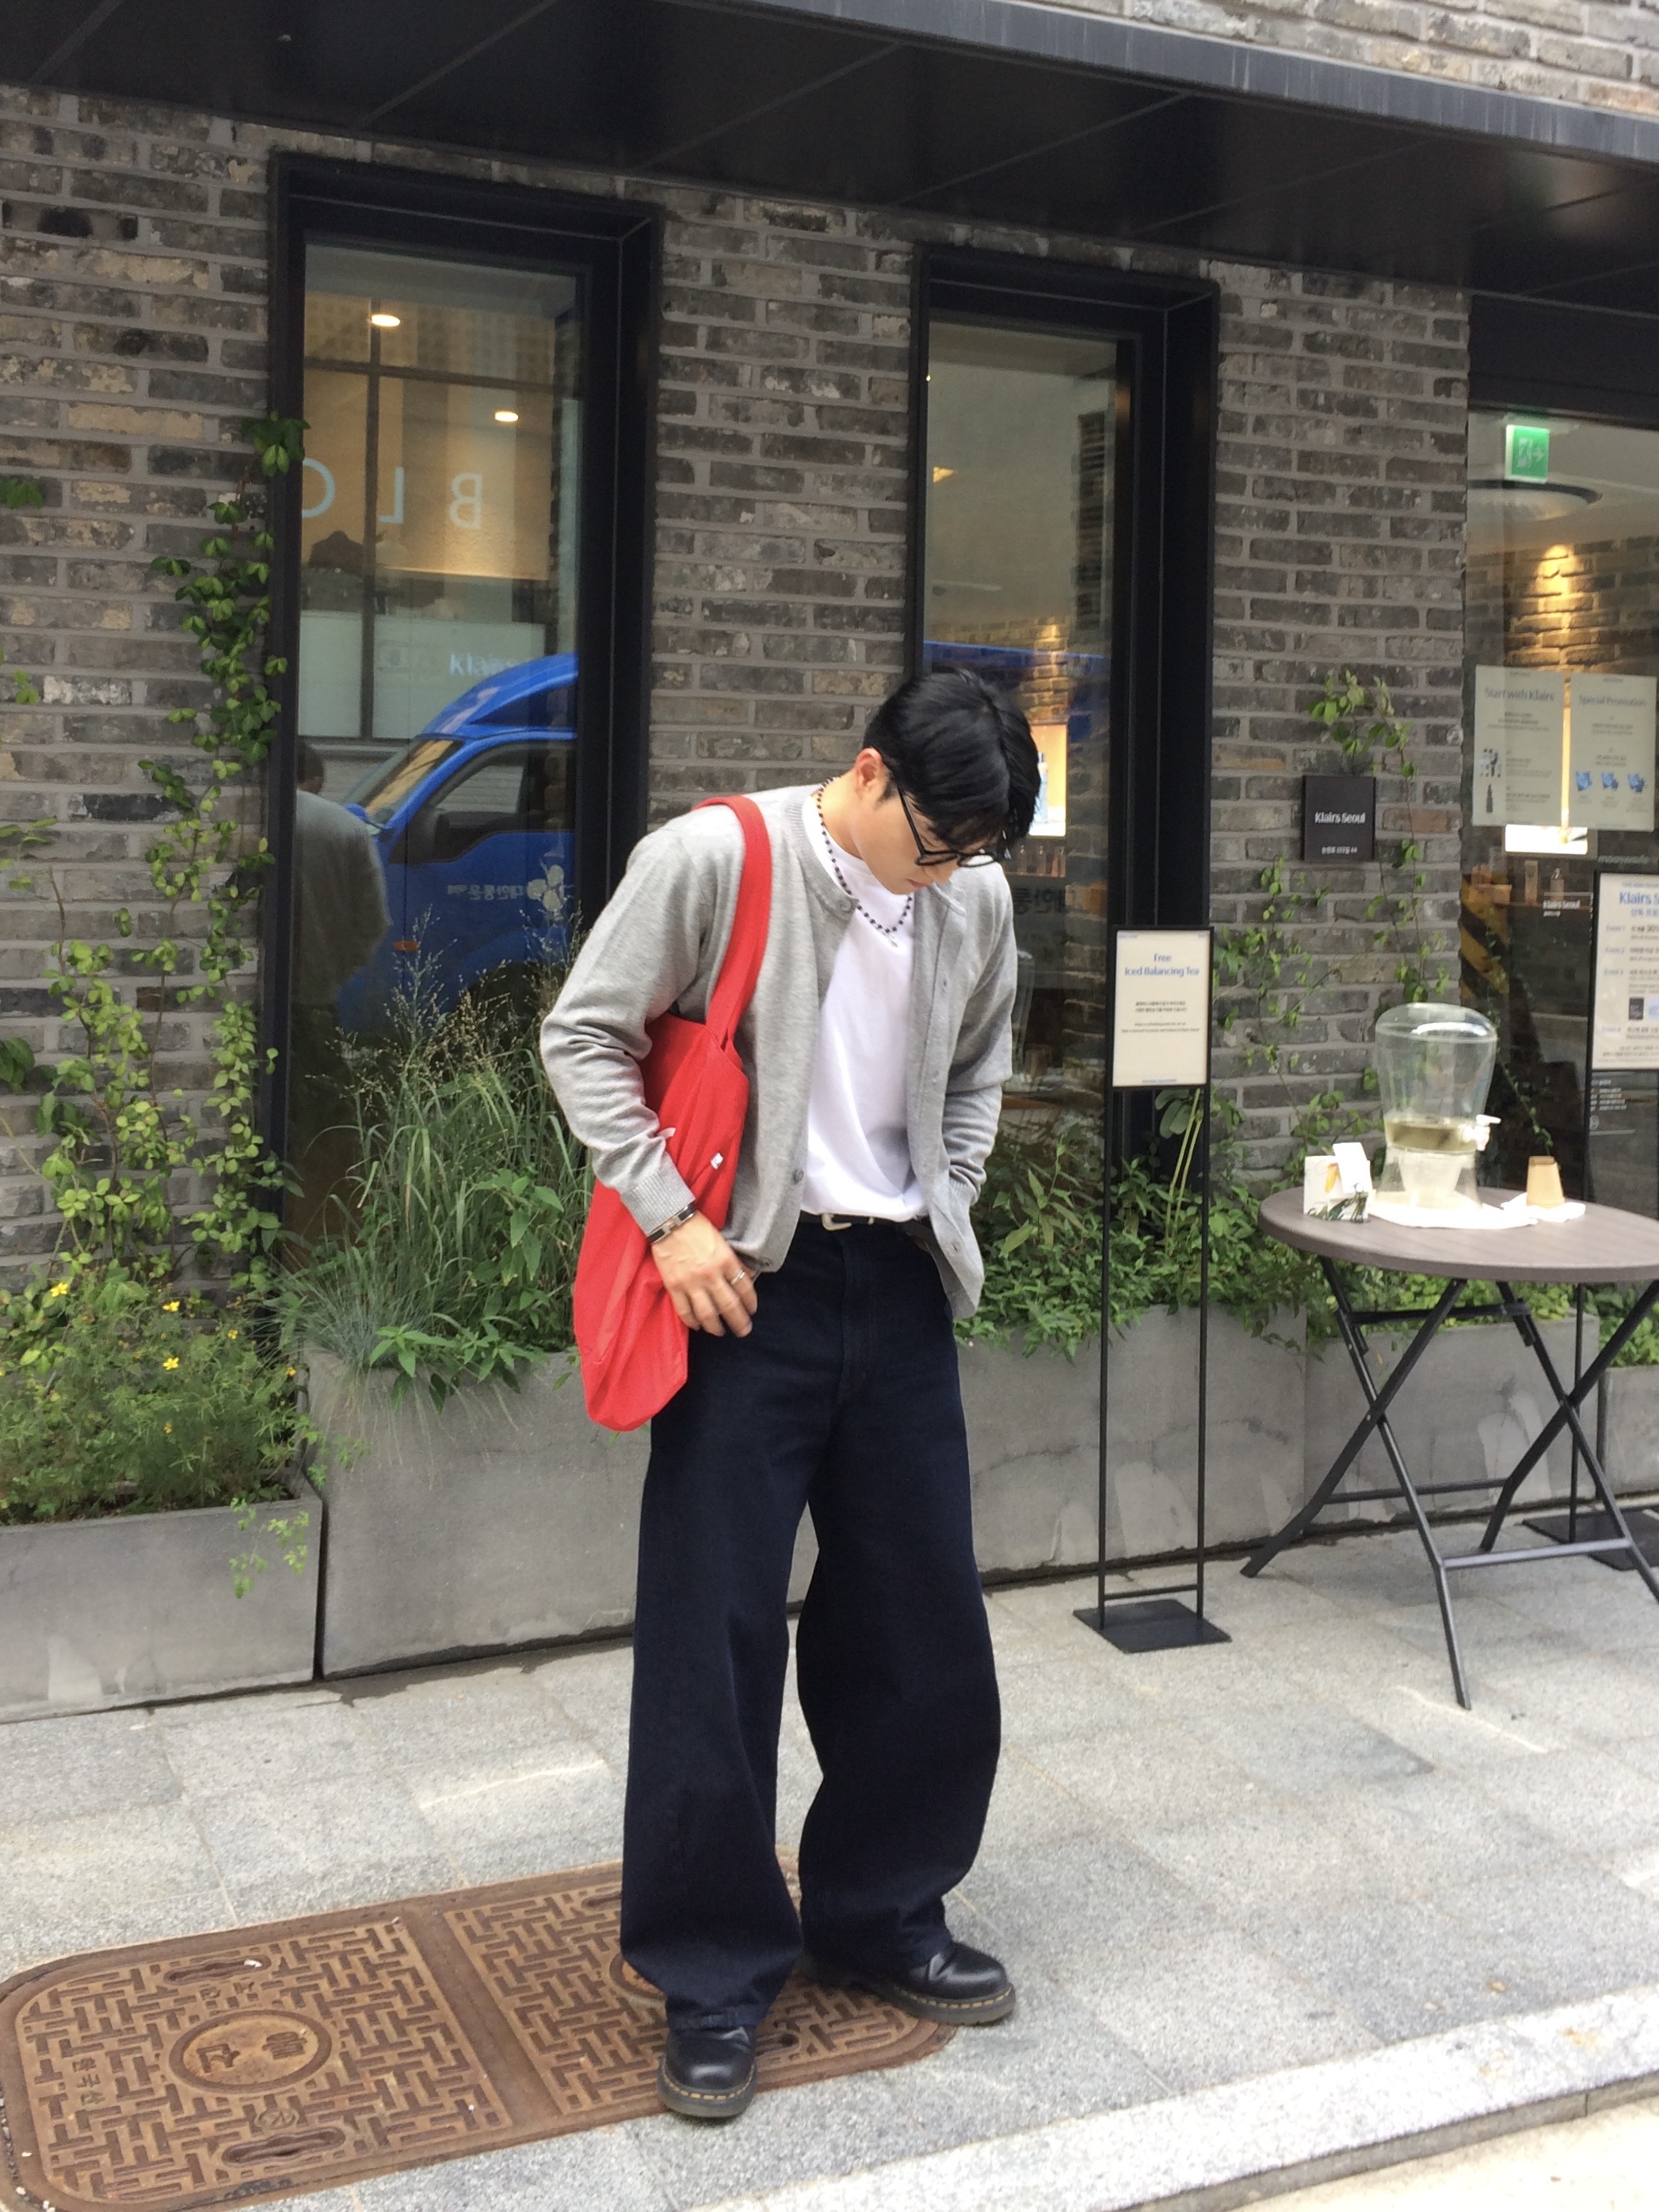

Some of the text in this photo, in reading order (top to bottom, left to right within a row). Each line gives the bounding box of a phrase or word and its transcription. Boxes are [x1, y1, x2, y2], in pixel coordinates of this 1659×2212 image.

[1314, 811, 1366, 824] Klairs Seoul
[1619, 891, 1652, 905] Klairs
[1154, 953, 1172, 962] Free
[1124, 966, 1199, 978] Iced Balancing Tea
